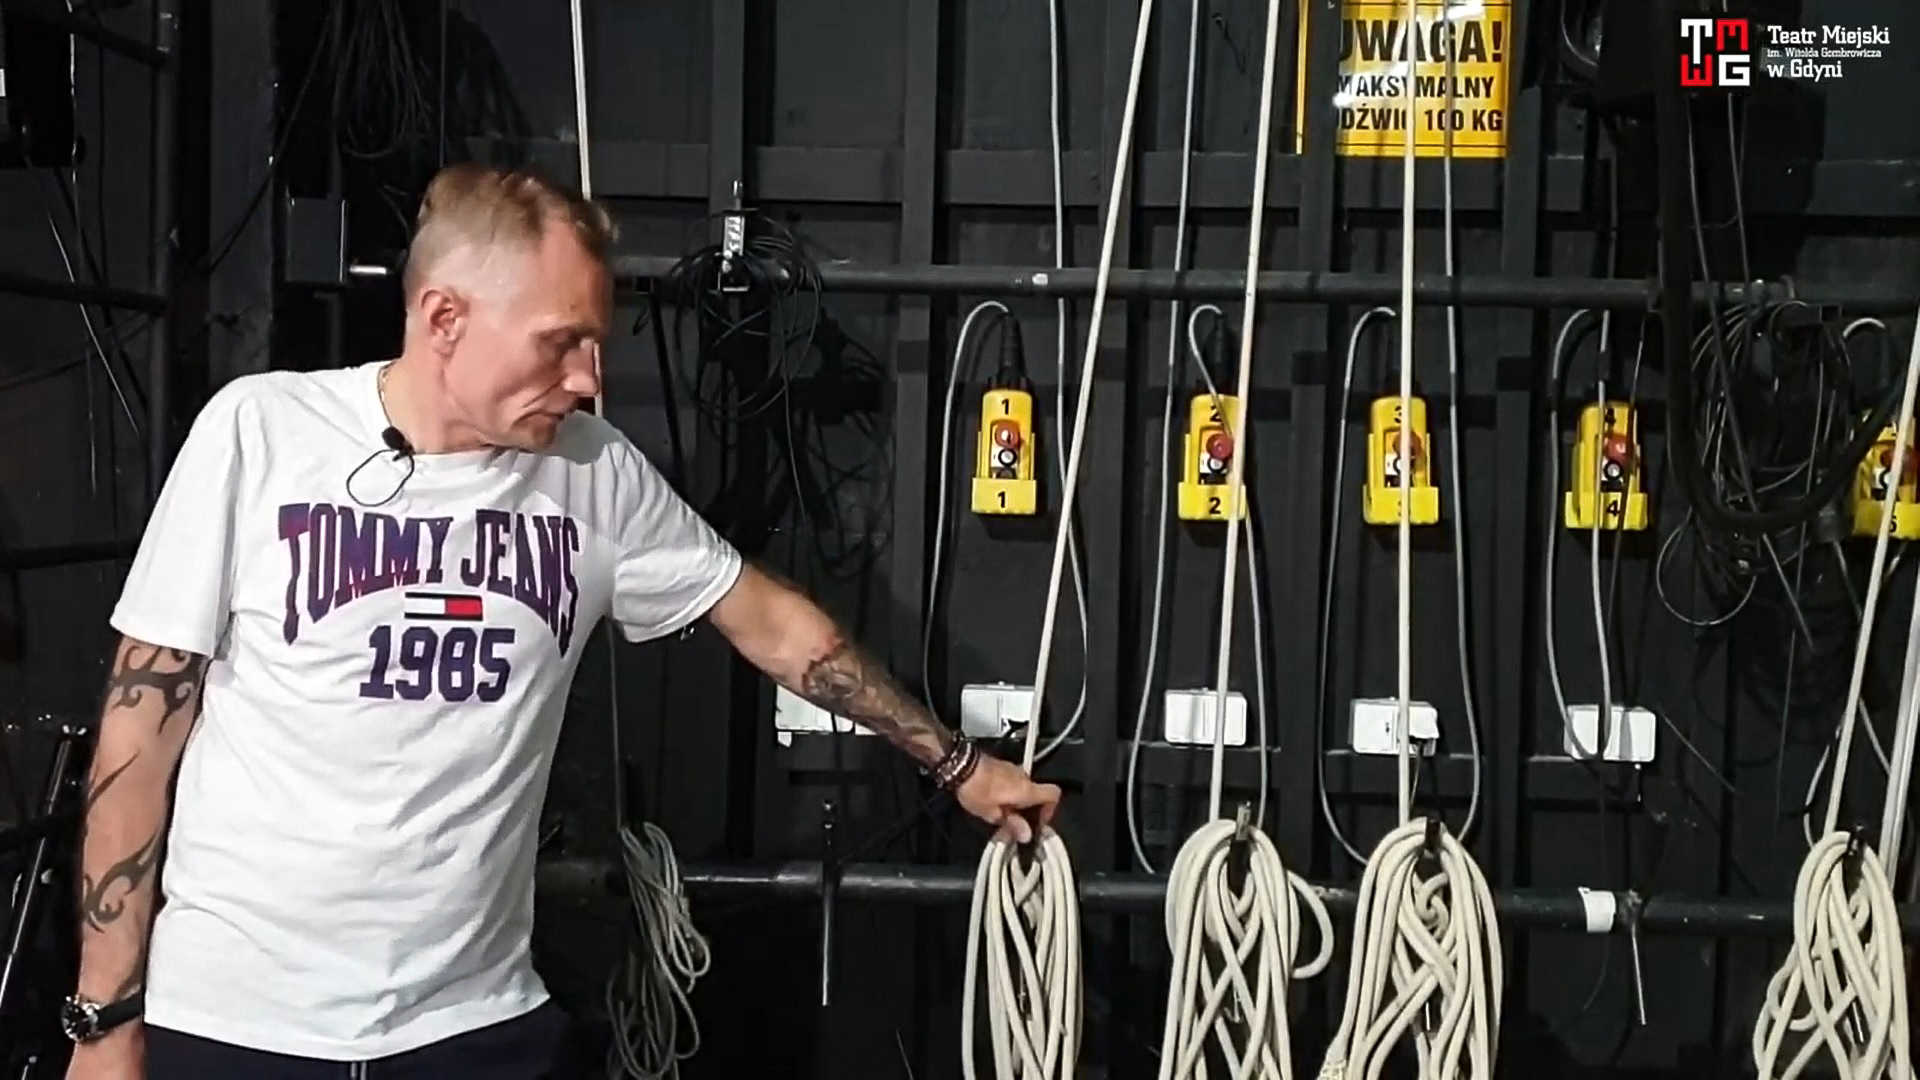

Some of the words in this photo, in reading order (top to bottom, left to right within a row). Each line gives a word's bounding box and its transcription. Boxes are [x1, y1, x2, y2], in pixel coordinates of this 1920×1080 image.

[1472, 109, 1503, 131] KG
[1001, 398, 1010, 416] 1
[998, 490, 1007, 509] 1
[1208, 496, 1222, 515] 2
[1606, 499, 1620, 518] 4
[278, 502, 454, 646] TOMMY
[460, 508, 580, 659] JEANS
[359, 625, 515, 702] 1985
